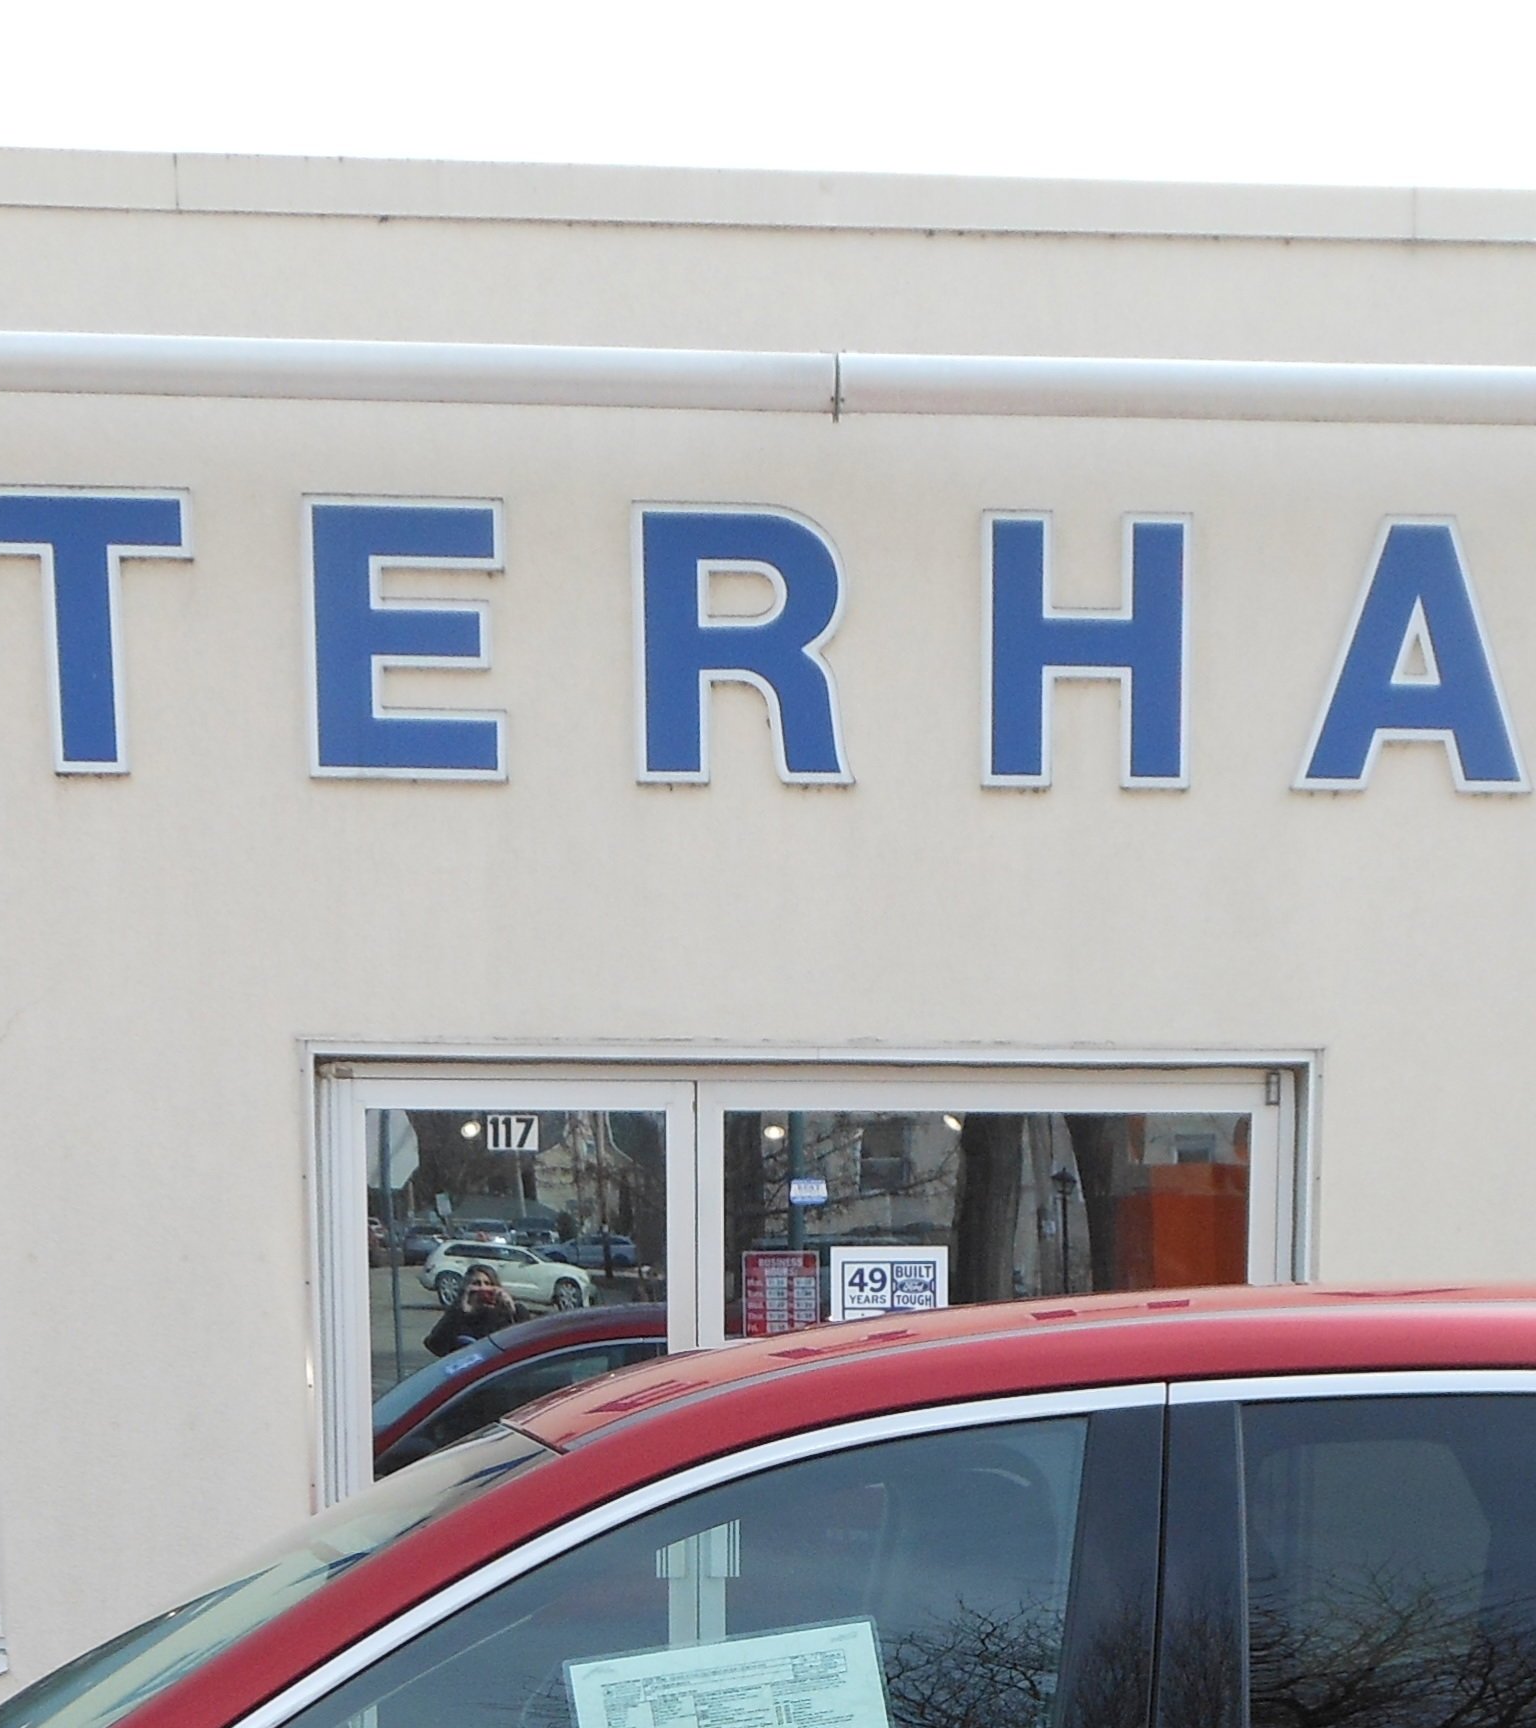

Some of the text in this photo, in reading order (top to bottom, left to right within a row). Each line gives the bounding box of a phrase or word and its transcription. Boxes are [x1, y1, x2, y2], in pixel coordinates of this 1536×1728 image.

[490, 1116, 537, 1149] 117
[895, 1265, 932, 1279] BUILT
[848, 1267, 887, 1293] 49
[902, 1281, 925, 1292] Ford
[849, 1294, 887, 1305] YEARS
[895, 1294, 932, 1306] TOUGH
